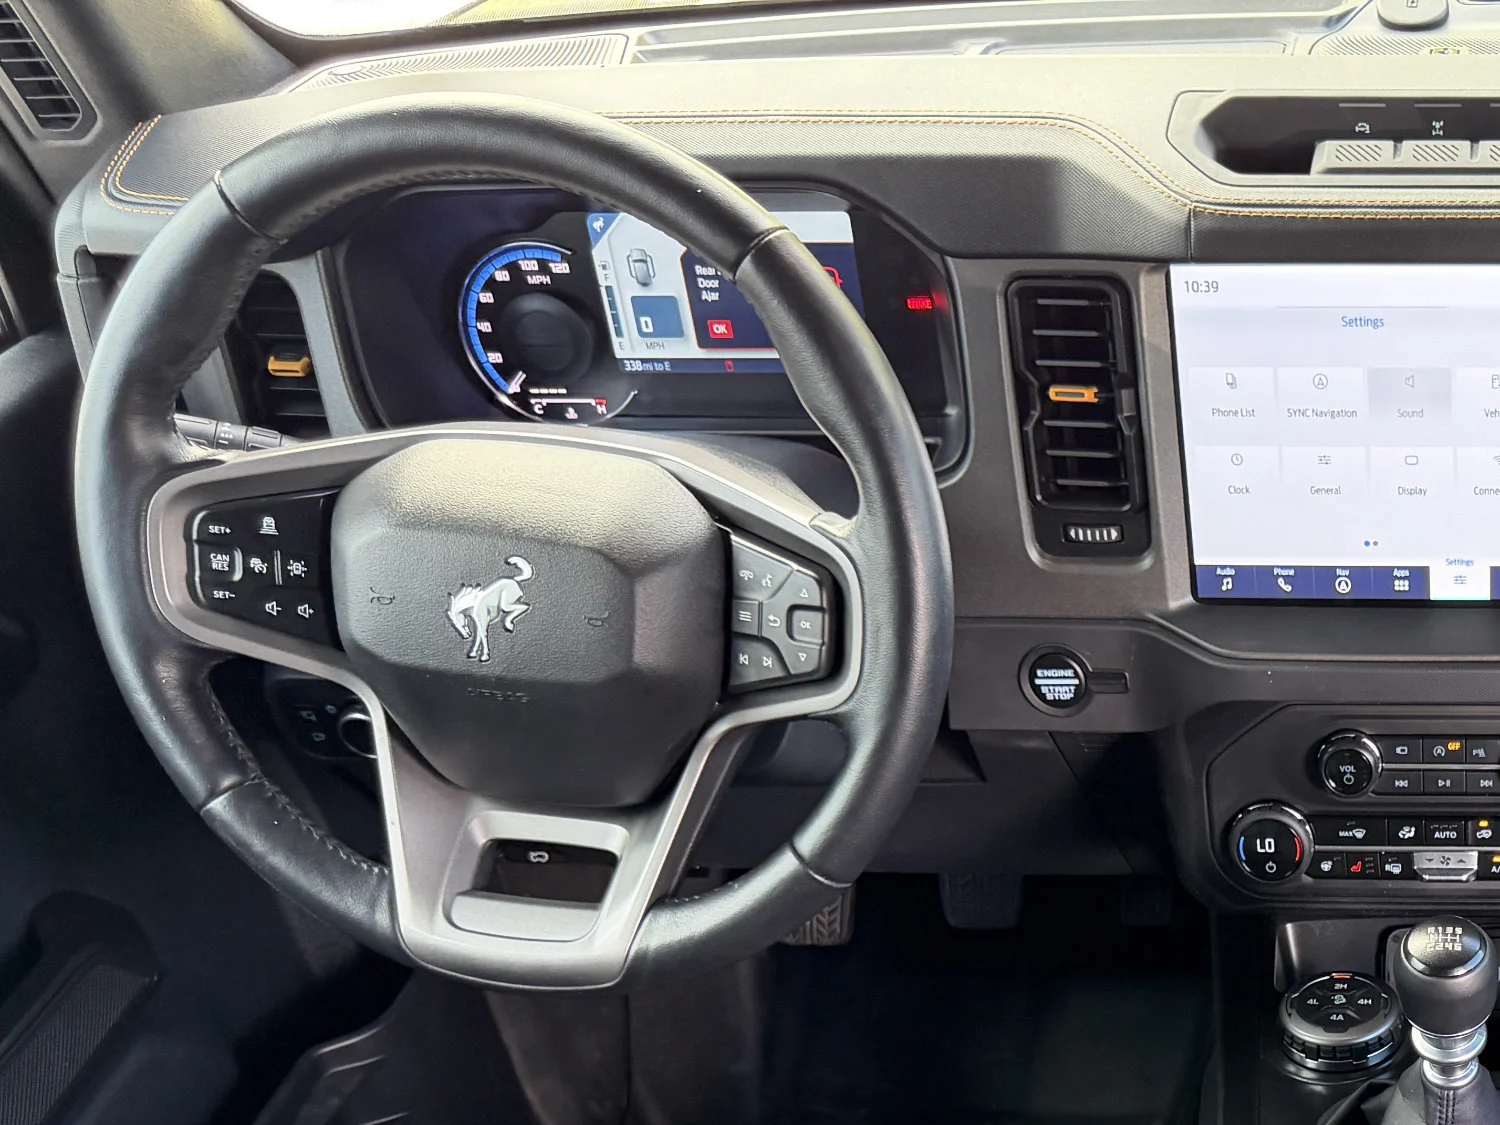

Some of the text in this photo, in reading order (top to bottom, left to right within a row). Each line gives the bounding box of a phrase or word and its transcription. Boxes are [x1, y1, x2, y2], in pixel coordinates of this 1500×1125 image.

[518, 260, 539, 271] 100
[549, 263, 570, 274] 120
[494, 270, 510, 282] 80
[526, 275, 551, 285] MPH
[697, 278, 719, 289] Door
[1184, 280, 1219, 293] 10:39
[479, 293, 494, 303] 60
[701, 291, 720, 302] Ajar
[639, 316, 654, 333] 0
[1341, 315, 1385, 329] Settings
[476, 322, 492, 333] 40
[712, 324, 728, 335] OK
[618, 342, 625, 350] E
[645, 342, 665, 350] MPH
[487, 352, 503, 363] 20
[533, 403, 544, 414] C
[596, 404, 607, 414] H
[1212, 407, 1256, 418] Phone List
[1397, 408, 1424, 418] Sound
[1287, 408, 1357, 420] SYNC Navigation
[1228, 484, 1250, 495] Clock
[1310, 484, 1341, 495] General
[1397, 485, 1428, 497] Display
[210, 553, 230, 562] CAN
[1446, 557, 1474, 568] Settings
[211, 562, 230, 571] RES
[1216, 567, 1236, 577] Audio
[1273, 567, 1295, 577] Phone
[1336, 568, 1350, 576] Nav
[1393, 568, 1410, 578] Apps
[800, 620, 812, 630] OK
[1036, 668, 1075, 677] ENGINE
[1040, 685, 1076, 694] START
[1447, 741, 1462, 751] OFF
[1339, 765, 1357, 773] VOL
[1338, 830, 1353, 838] MAX
[1434, 831, 1457, 840] AUTO
[1256, 837, 1275, 853] LO
